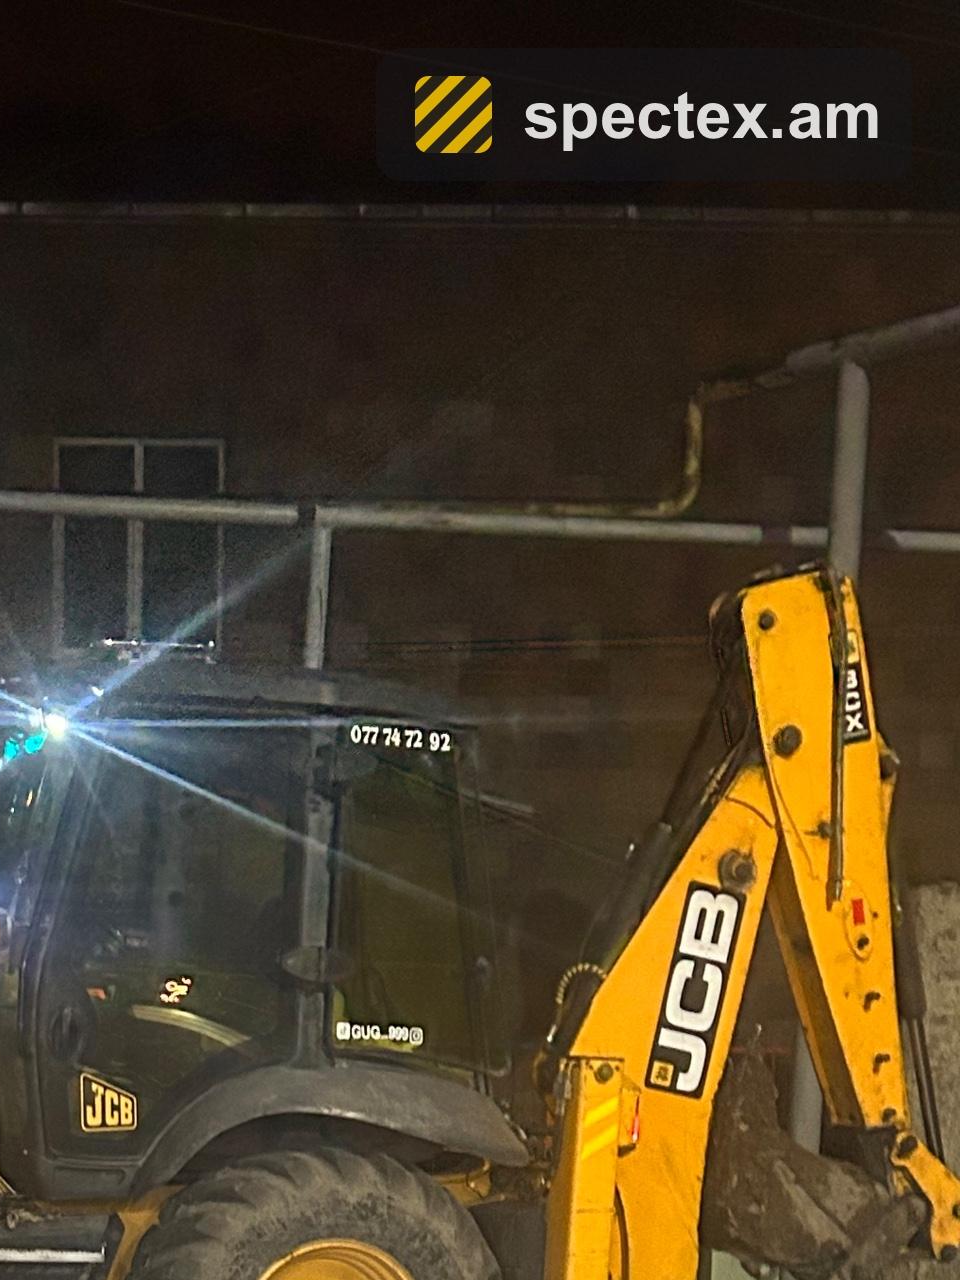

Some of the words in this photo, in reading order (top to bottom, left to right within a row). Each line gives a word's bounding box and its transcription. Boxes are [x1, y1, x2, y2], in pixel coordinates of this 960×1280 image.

[429, 732, 451, 752] 92
[657, 887, 740, 1092] JCB
[86, 1081, 134, 1127] JCB
